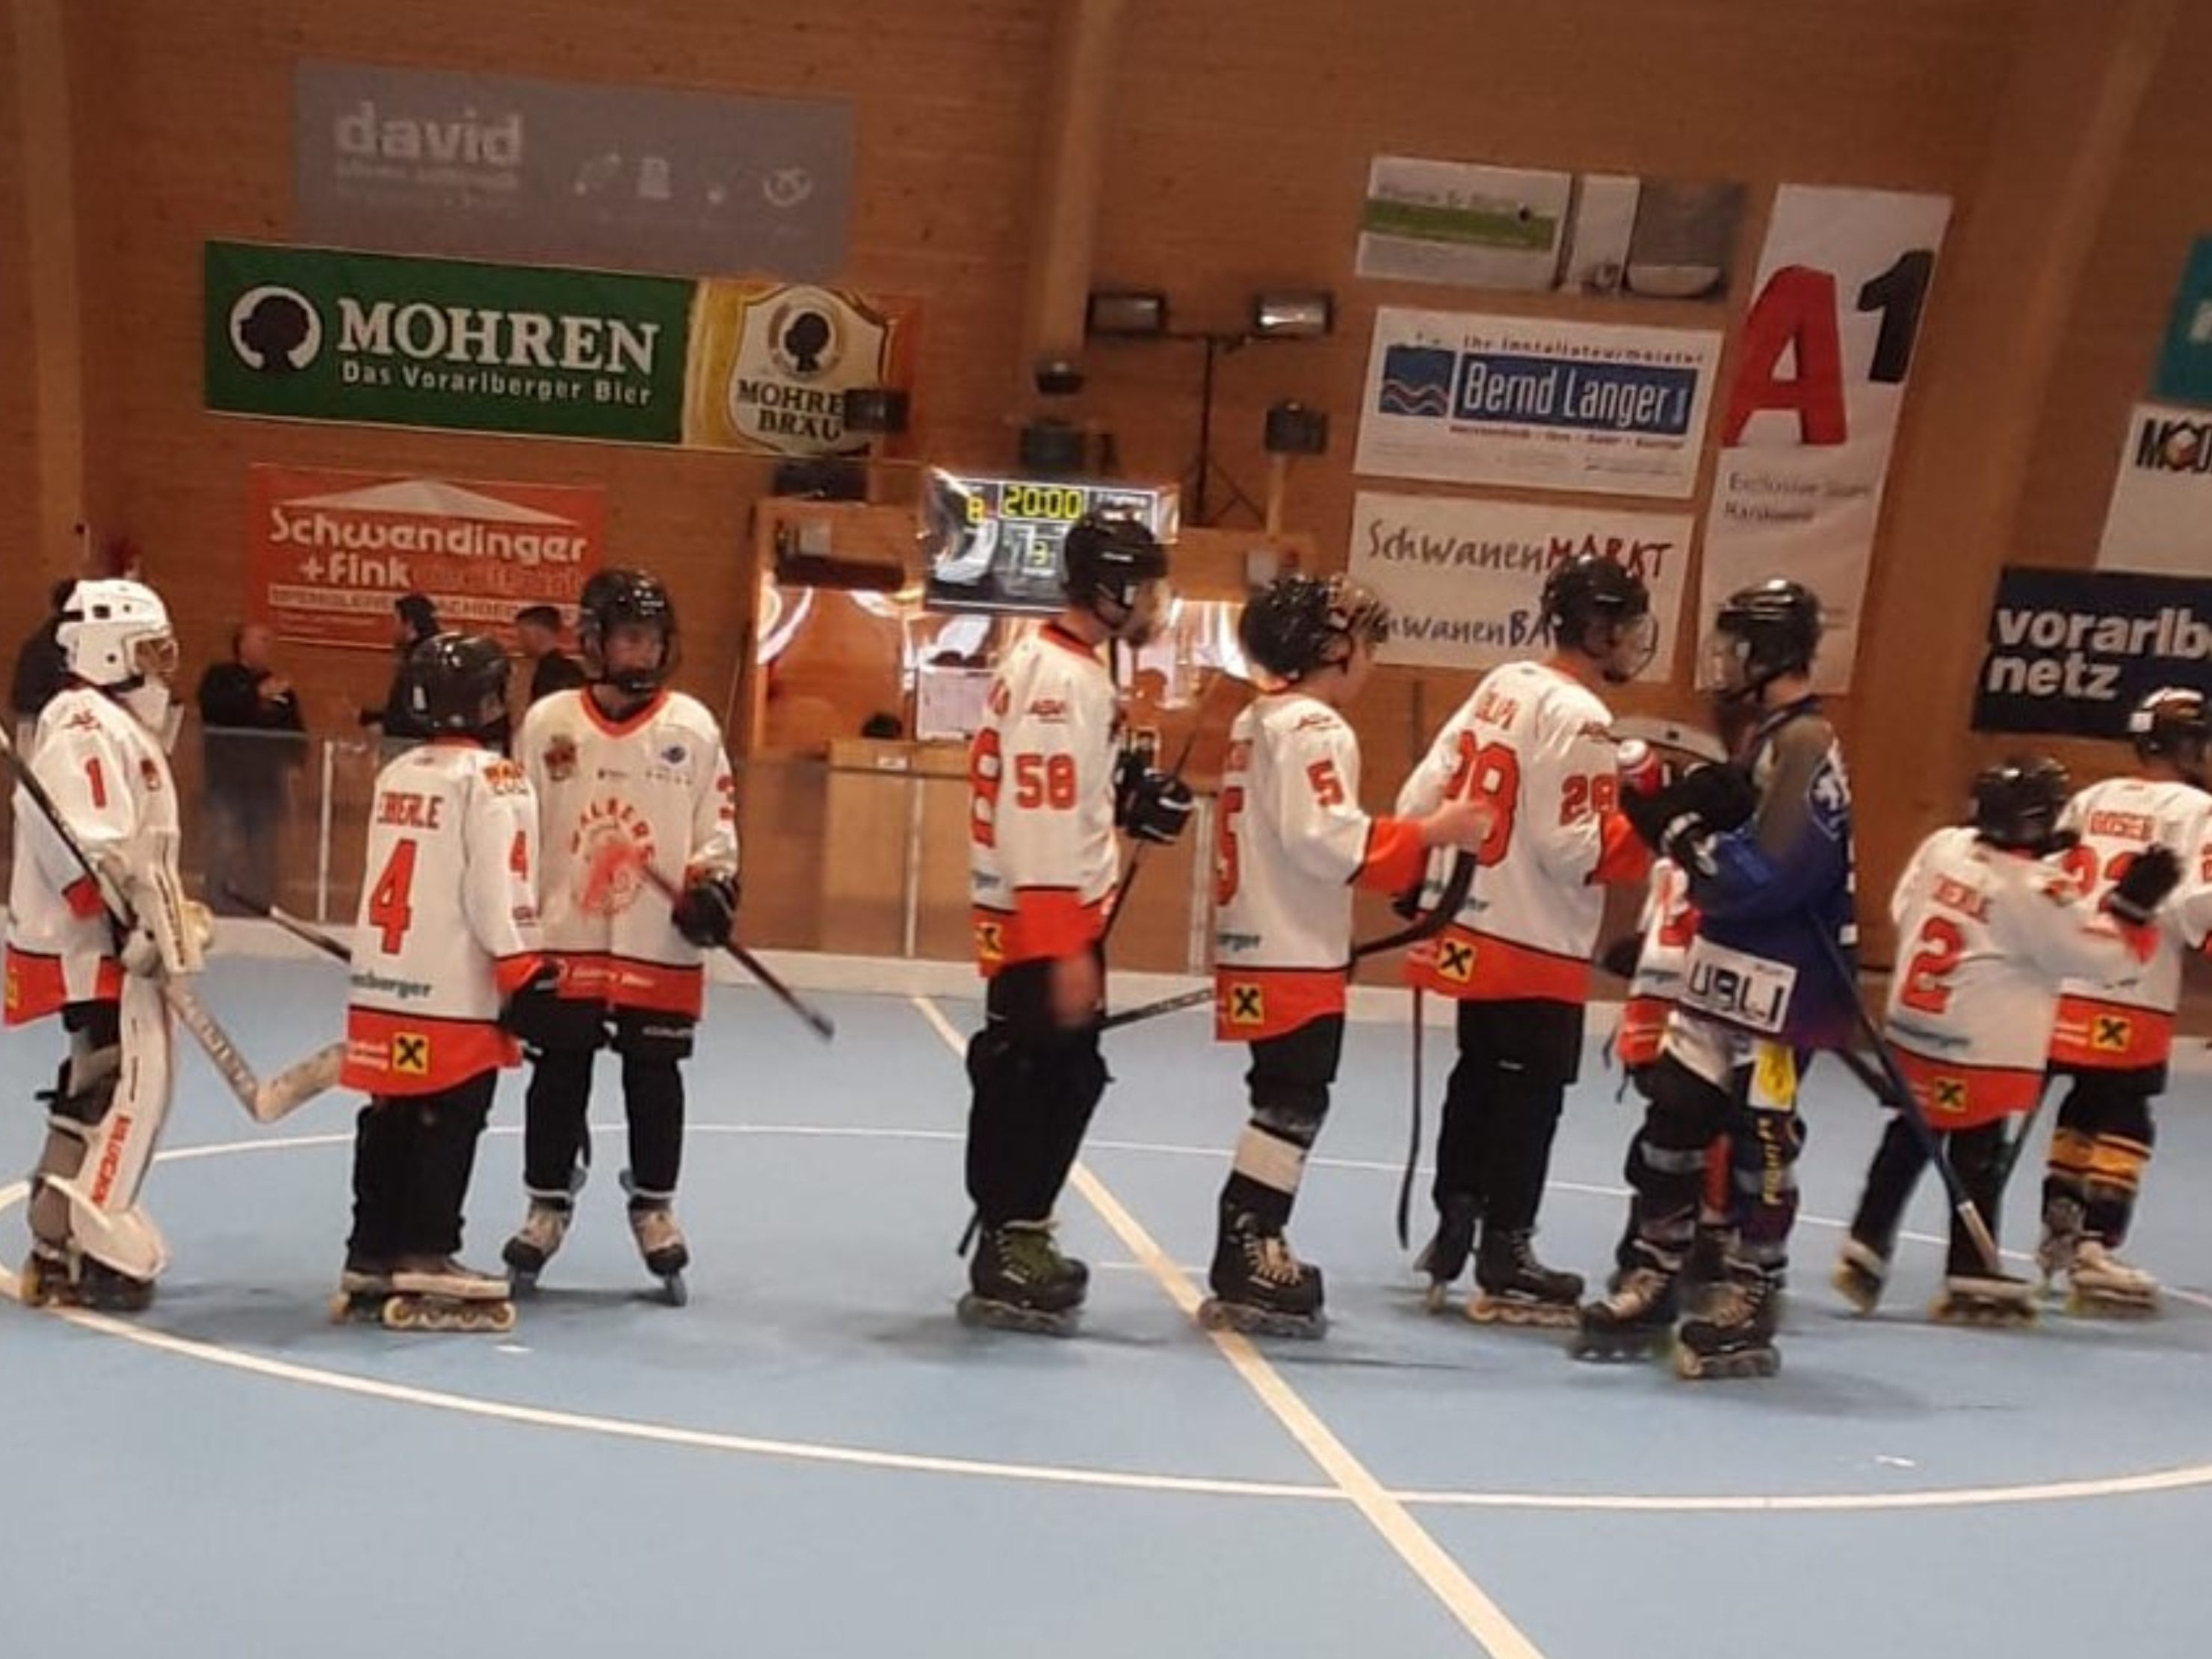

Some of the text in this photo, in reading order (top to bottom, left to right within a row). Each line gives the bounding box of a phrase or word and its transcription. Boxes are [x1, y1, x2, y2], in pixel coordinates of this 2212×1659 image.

[336, 99, 521, 165] david
[338, 297, 661, 374] MOHREN
[1723, 249, 1935, 447] A1
[343, 360, 651, 405] Das Vorarlberger Bier
[738, 378, 844, 416] MOHRE
[1464, 362, 1558, 415] Bernd
[1563, 368, 1675, 427] Langer
[1005, 486, 1083, 519] 20:00
[269, 507, 588, 566] Schwendinger
[1995, 606, 2212, 659] vorarlb
[1986, 652, 2121, 701] netz
[85, 757, 107, 808] 1
[1015, 752, 1076, 810] 58
[1306, 759, 1344, 807] 5
[508, 830, 529, 881] 4
[368, 838, 417, 955] 4
[1900, 915, 1964, 1014] 2
